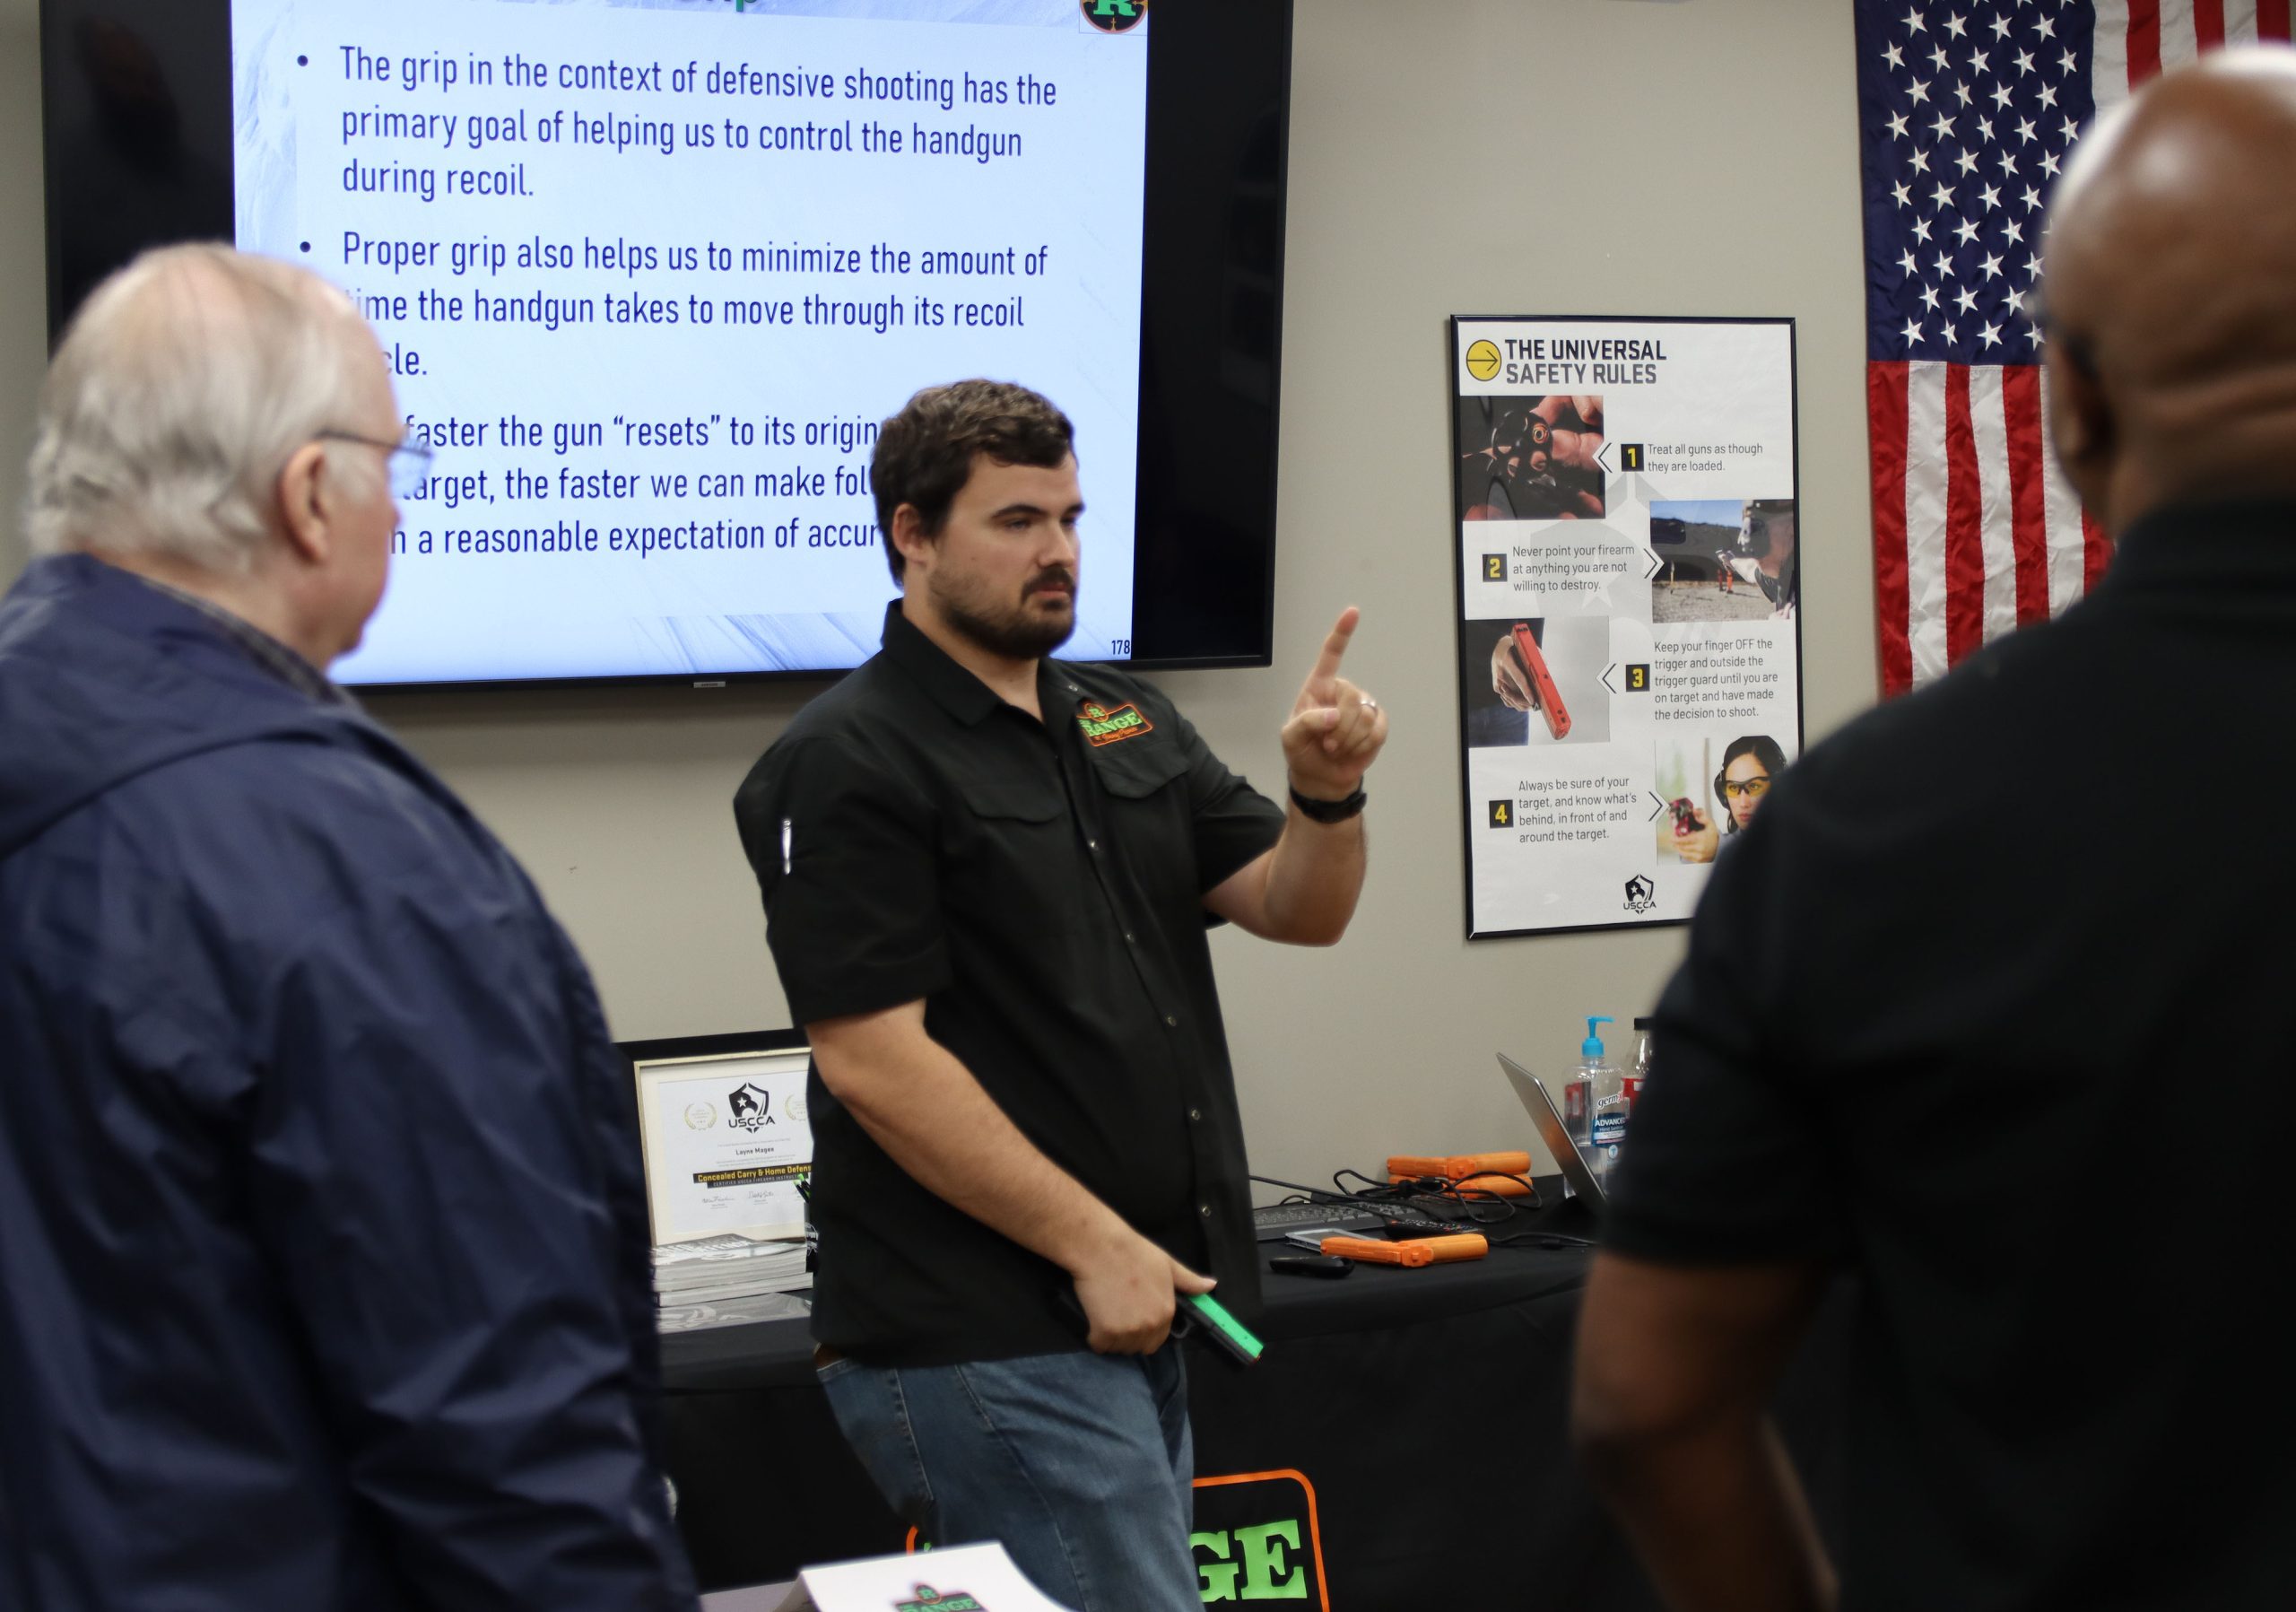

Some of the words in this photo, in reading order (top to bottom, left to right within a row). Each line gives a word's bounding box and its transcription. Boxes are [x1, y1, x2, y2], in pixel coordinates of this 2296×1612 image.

[340, 46, 389, 81] The
[403, 51, 457, 92] grip
[470, 53, 491, 84] in
[503, 54, 547, 87] the
[560, 60, 661, 91] context
[673, 61, 697, 92] of
[707, 62, 833, 98] defensive
[845, 67, 952, 110] shooting
[965, 72, 1007, 103] has
[1017, 74, 1056, 105] the
[343, 105, 457, 148] primary
[468, 109, 526, 149] goal
[538, 110, 563, 142] of
[574, 111, 674, 155] helping
[686, 124, 714, 147] us
[725, 118, 748, 148] to
[760, 120, 852, 151] control
[862, 121, 901, 152] the
[914, 122, 1021, 164] handgun
[344, 158, 434, 202] during
[448, 163, 533, 196] recoil.
[344, 231, 439, 274] Proper
[452, 236, 505, 275] grip
[517, 236, 572, 268] also
[586, 237, 657, 278] helps
[669, 248, 697, 270] us
[708, 242, 731, 271] to
[744, 241, 860, 273] minimize
[871, 242, 910, 274] the
[922, 248, 1015, 274] amount
[1025, 246, 1048, 275] of
[418, 289, 462, 321] the
[475, 289, 593, 331] handgun
[604, 292, 678, 323] takes
[689, 295, 712, 324] to
[725, 301, 793, 324] move
[804, 294, 903, 334] through
[915, 296, 944, 326] its
[954, 296, 1023, 326] recoil
[1505, 339, 1544, 360] THE
[1552, 340, 1666, 360] UNIVERSAL
[1507, 363, 1586, 383] SAFETY
[1594, 364, 1656, 384] RULES
[406, 414, 489, 447] faster
[500, 415, 542, 446] the
[554, 423, 602, 455] gun
[730, 417, 753, 445] to
[765, 415, 795, 445] its
[1627, 448, 1636, 467] 1
[1648, 444, 1672, 454] Treat
[1675, 444, 1685, 454] all
[1689, 446, 1711, 457] guns
[1715, 446, 1726, 454] as
[1728, 443, 1762, 456] though
[1648, 461, 1668, 474] they
[1690, 460, 1726, 471] loaded.
[505, 467, 548, 499] the
[559, 467, 639, 499] faster
[651, 475, 687, 497] we
[699, 475, 744, 497] can
[756, 466, 824, 496] make
[419, 531, 431, 553] a
[445, 520, 597, 553] reasonable
[610, 519, 763, 559] expectation
[776, 518, 799, 548] of
[1513, 546, 1543, 556] Never
[1546, 545, 1570, 559] point
[1574, 547, 1596, 558] your
[1598, 545, 1634, 555] firearm
[1490, 558, 1501, 578] 2
[1513, 564, 1523, 574] at
[1526, 562, 1570, 577] anything
[1572, 564, 1589, 575] you
[1593, 564, 1608, 572] are
[1612, 562, 1627, 571] not
[1514, 580, 1545, 594] willing
[1548, 581, 1558, 590] to
[1561, 579, 1600, 592] destroy.
[1111, 640, 1130, 655] 178
[1655, 641, 1679, 654] Keep
[1682, 643, 1702, 654] your
[1705, 640, 1733, 653] finger
[1735, 639, 1754, 649] OFF
[1757, 639, 1772, 649] the
[1655, 658, 1687, 672] trigger
[1690, 658, 1708, 668] and
[1710, 657, 1745, 667] outside
[1748, 656, 1763, 666] the
[1632, 668, 1644, 688] 3
[1655, 676, 1688, 688] trigger
[1690, 675, 1718, 687] guard
[1721, 673, 1741, 684] until
[1744, 675, 1760, 685] you
[1655, 695, 1666, 703] on
[1670, 693, 1699, 704] target
[1702, 691, 1719, 701] and
[1722, 691, 1744, 700] have
[1747, 689, 1773, 699] made
[1655, 710, 1670, 719] the
[1674, 709, 1714, 719] decision
[1718, 709, 1726, 718] to
[1729, 707, 1759, 717] shoot.
[1082, 711, 1143, 737] RANGE
[1518, 780, 1553, 793] Always
[1556, 779, 1568, 789] be
[1570, 780, 1592, 789] sure
[1595, 777, 1605, 788] of
[1607, 779, 1629, 789] your
[1519, 797, 1552, 810] target,
[1555, 796, 1573, 806] and
[1576, 795, 1602, 806] know
[1495, 805, 1508, 824] 4
[1519, 814, 1555, 825] behind,
[1559, 813, 1567, 823] in
[1570, 812, 1594, 823] front
[1597, 811, 1606, 822] of
[1610, 810, 1627, 821] and
[1520, 831, 1554, 842] around
[1557, 831, 1573, 841] the
[1576, 829, 1609, 841] target.
[1623, 901, 1657, 910] USCCA
[728, 1115, 775, 1128] USCCA
[735, 1149, 753, 1158] Layne
[698, 1172, 735, 1182] Concealed
[737, 1170, 757, 1180] Carry
[765, 1167, 786, 1176] Home
[902, 1599, 981, 1612] ANGE
